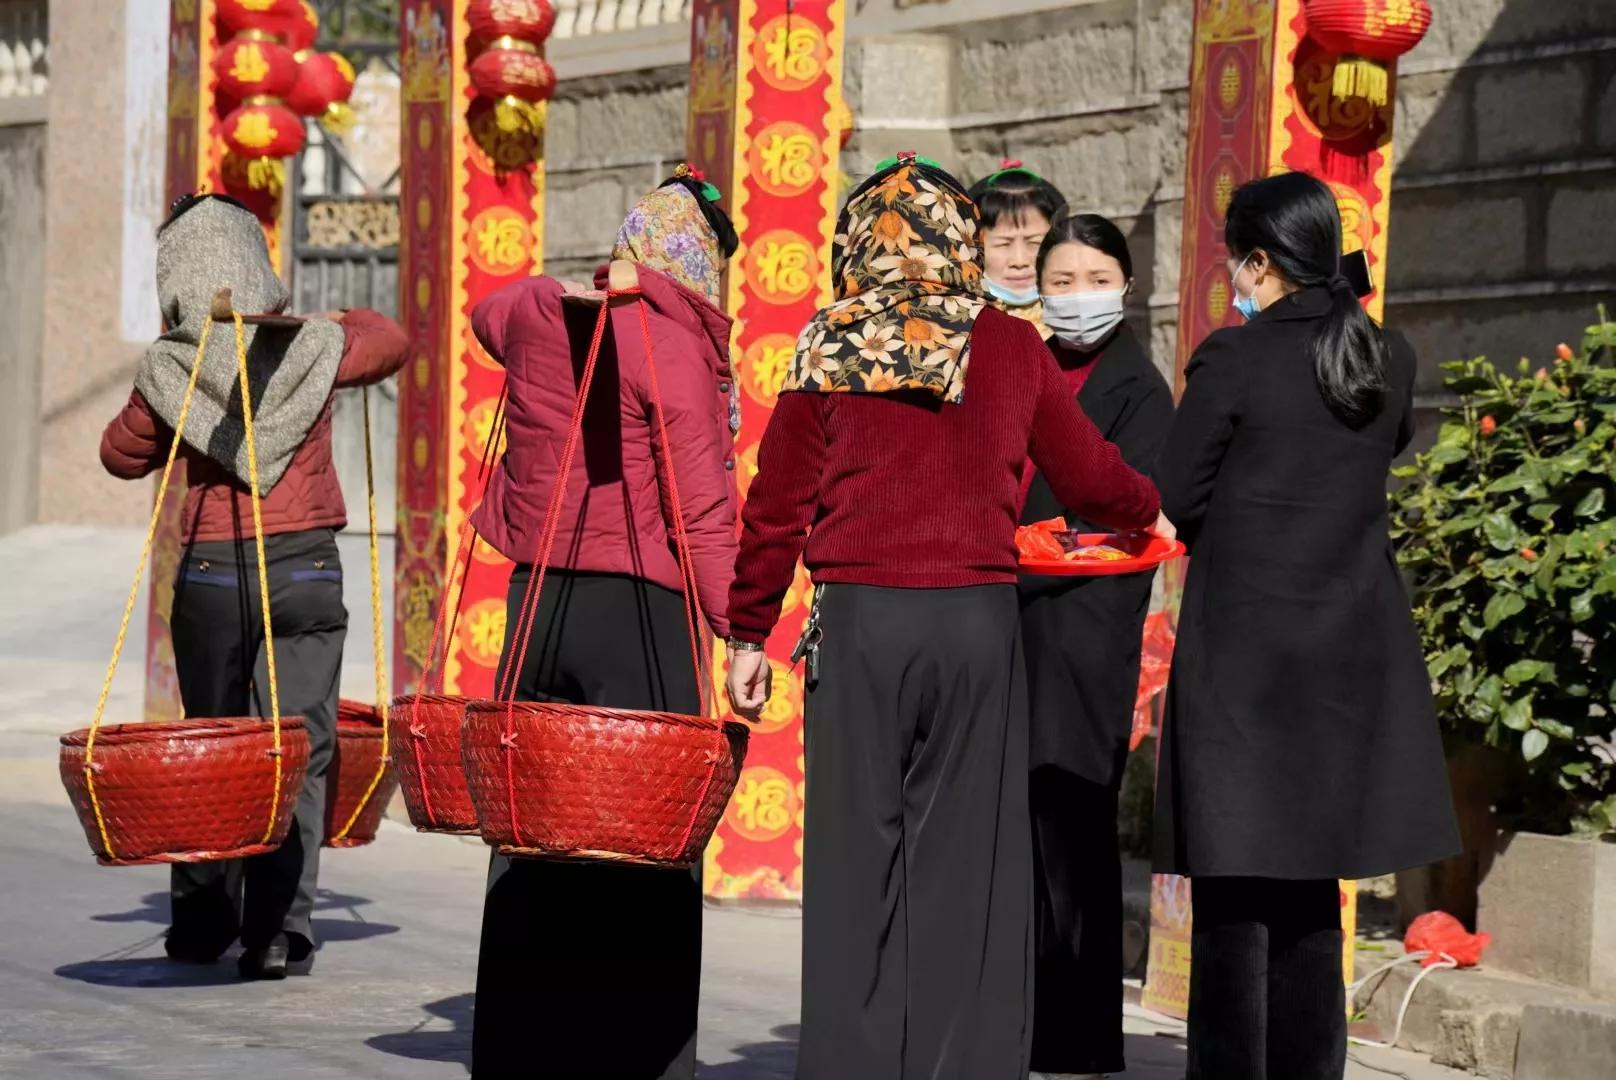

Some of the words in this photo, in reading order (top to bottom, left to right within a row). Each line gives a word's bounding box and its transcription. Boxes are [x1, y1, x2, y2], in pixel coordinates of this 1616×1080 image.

[765, 26, 819, 81] 福
[760, 132, 815, 188] 福
[478, 217, 526, 266] 福
[756, 240, 811, 295] 福
[735, 778, 790, 831] 福
